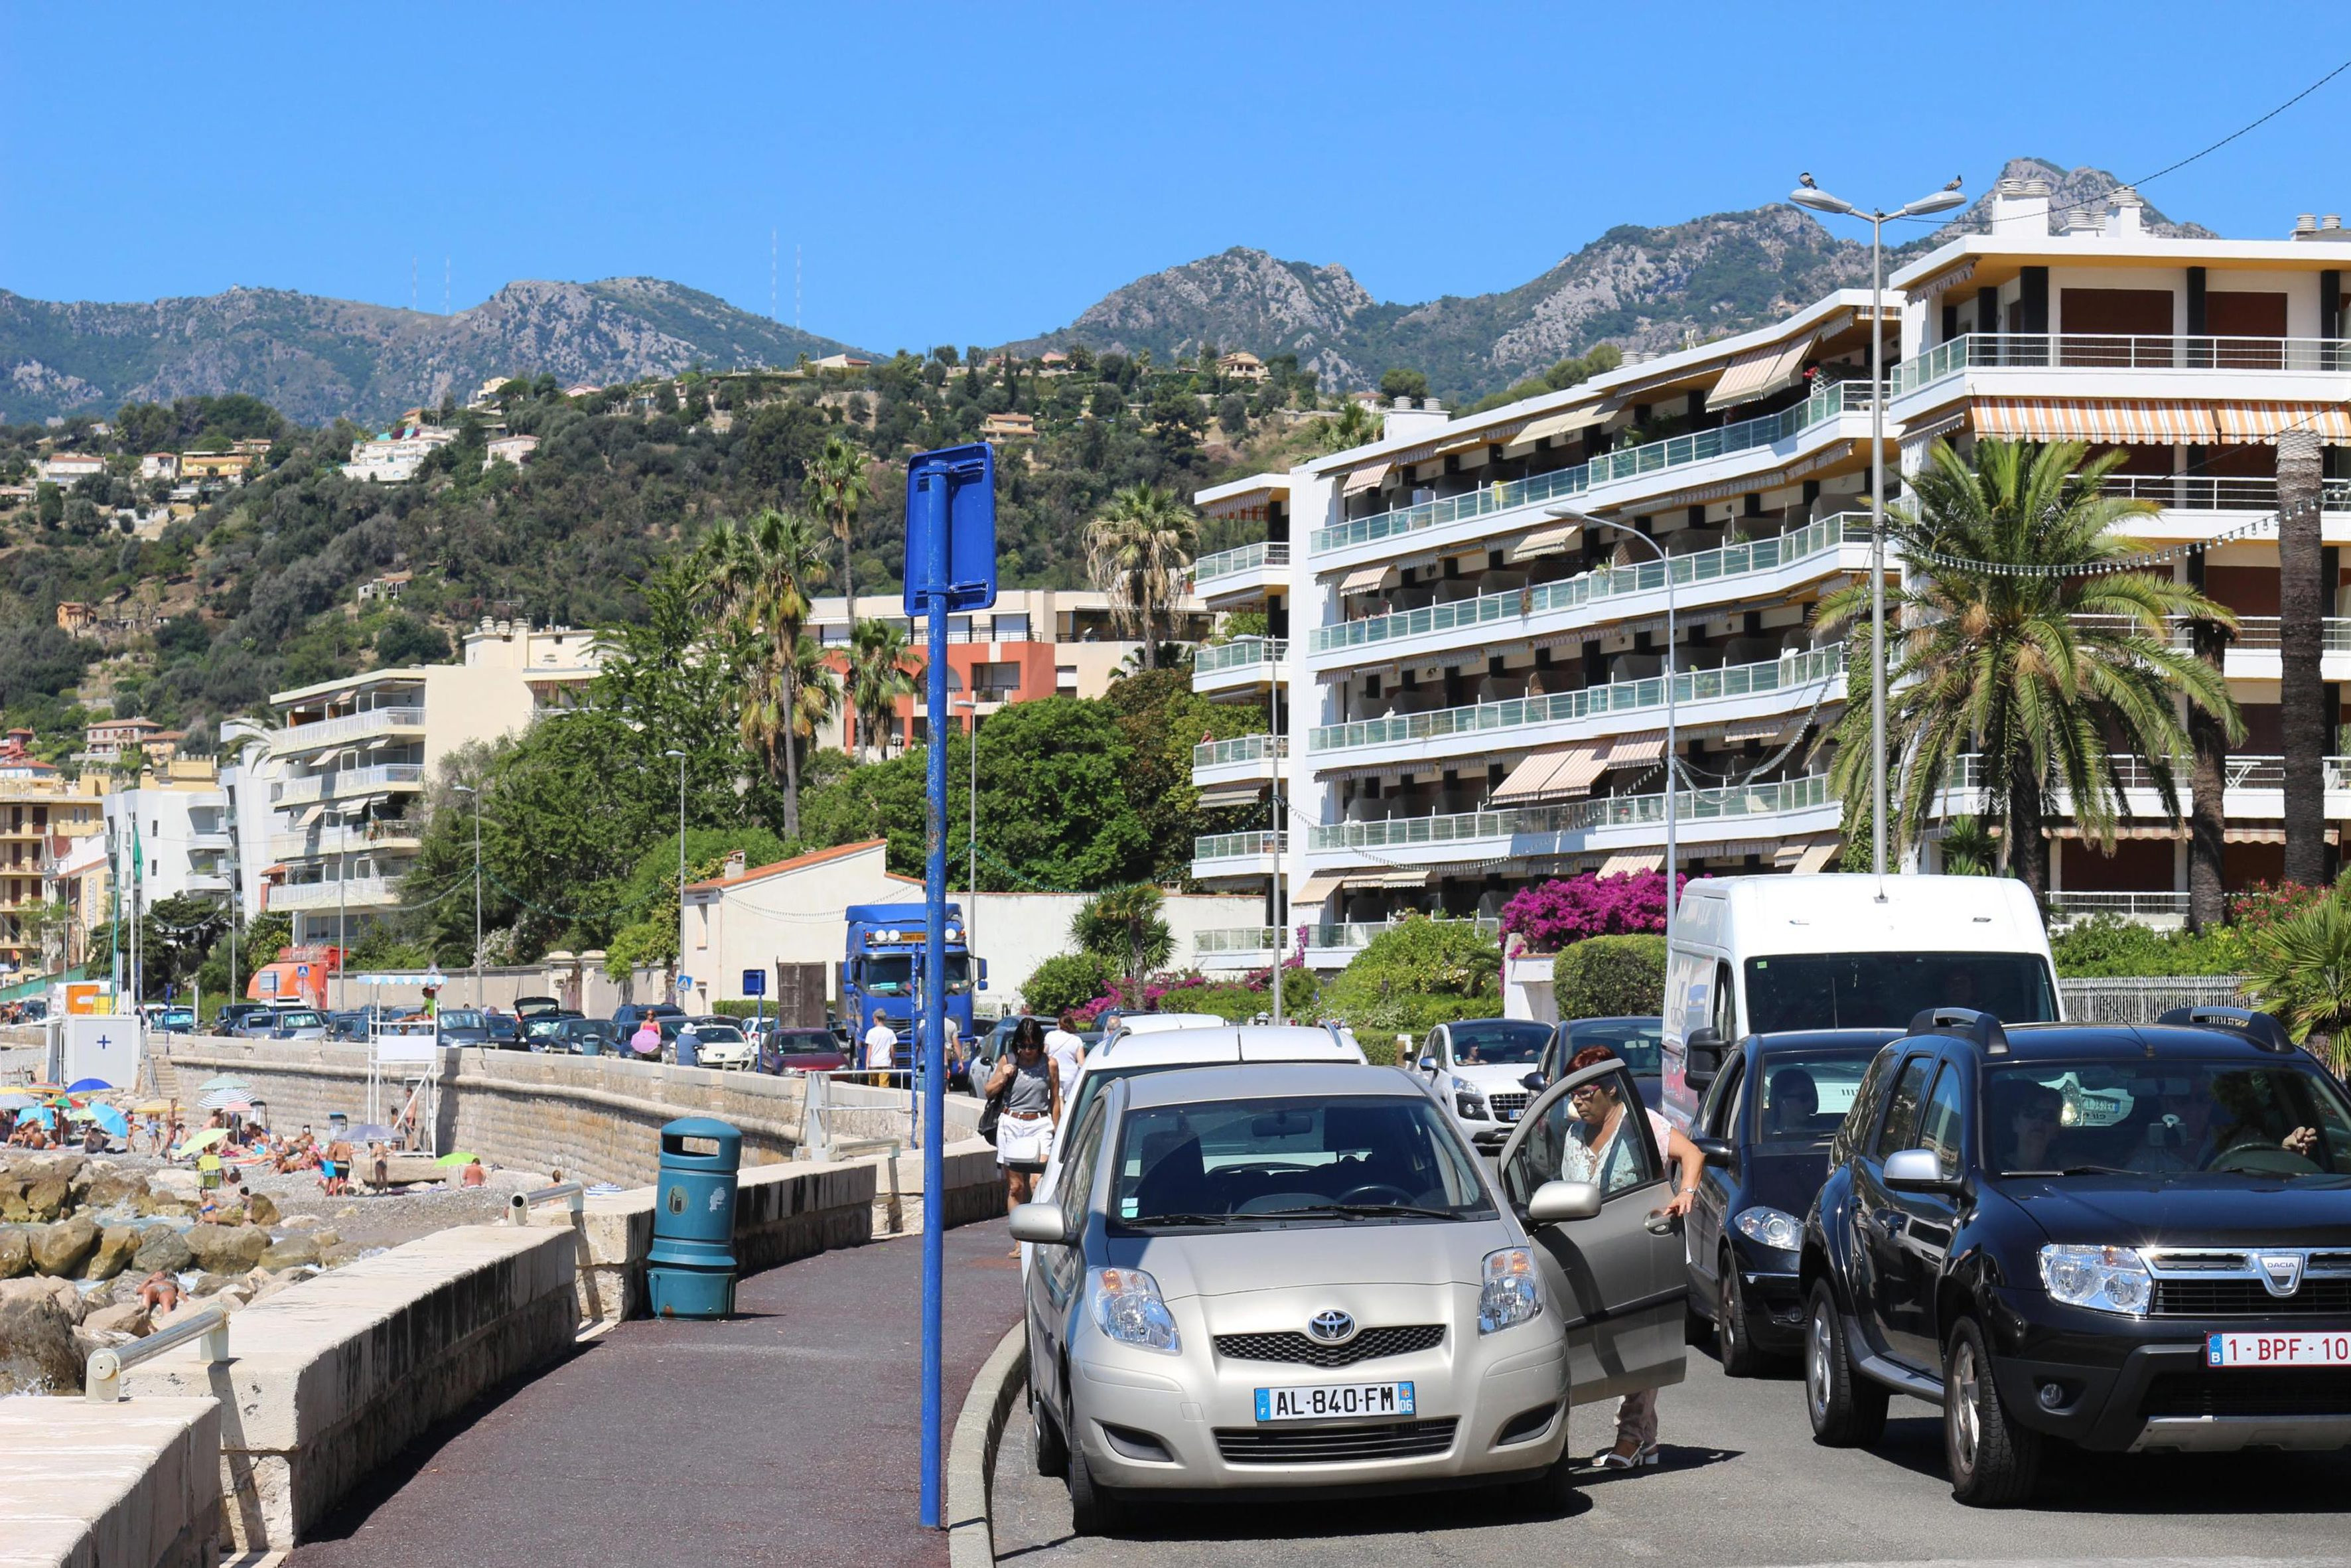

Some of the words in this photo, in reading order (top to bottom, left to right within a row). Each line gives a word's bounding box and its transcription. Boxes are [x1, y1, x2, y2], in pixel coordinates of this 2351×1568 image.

[2211, 1352, 2220, 1363] B
[1277, 1387, 1393, 1415] AL-840-FM
[1399, 1399, 1413, 1412] 06
